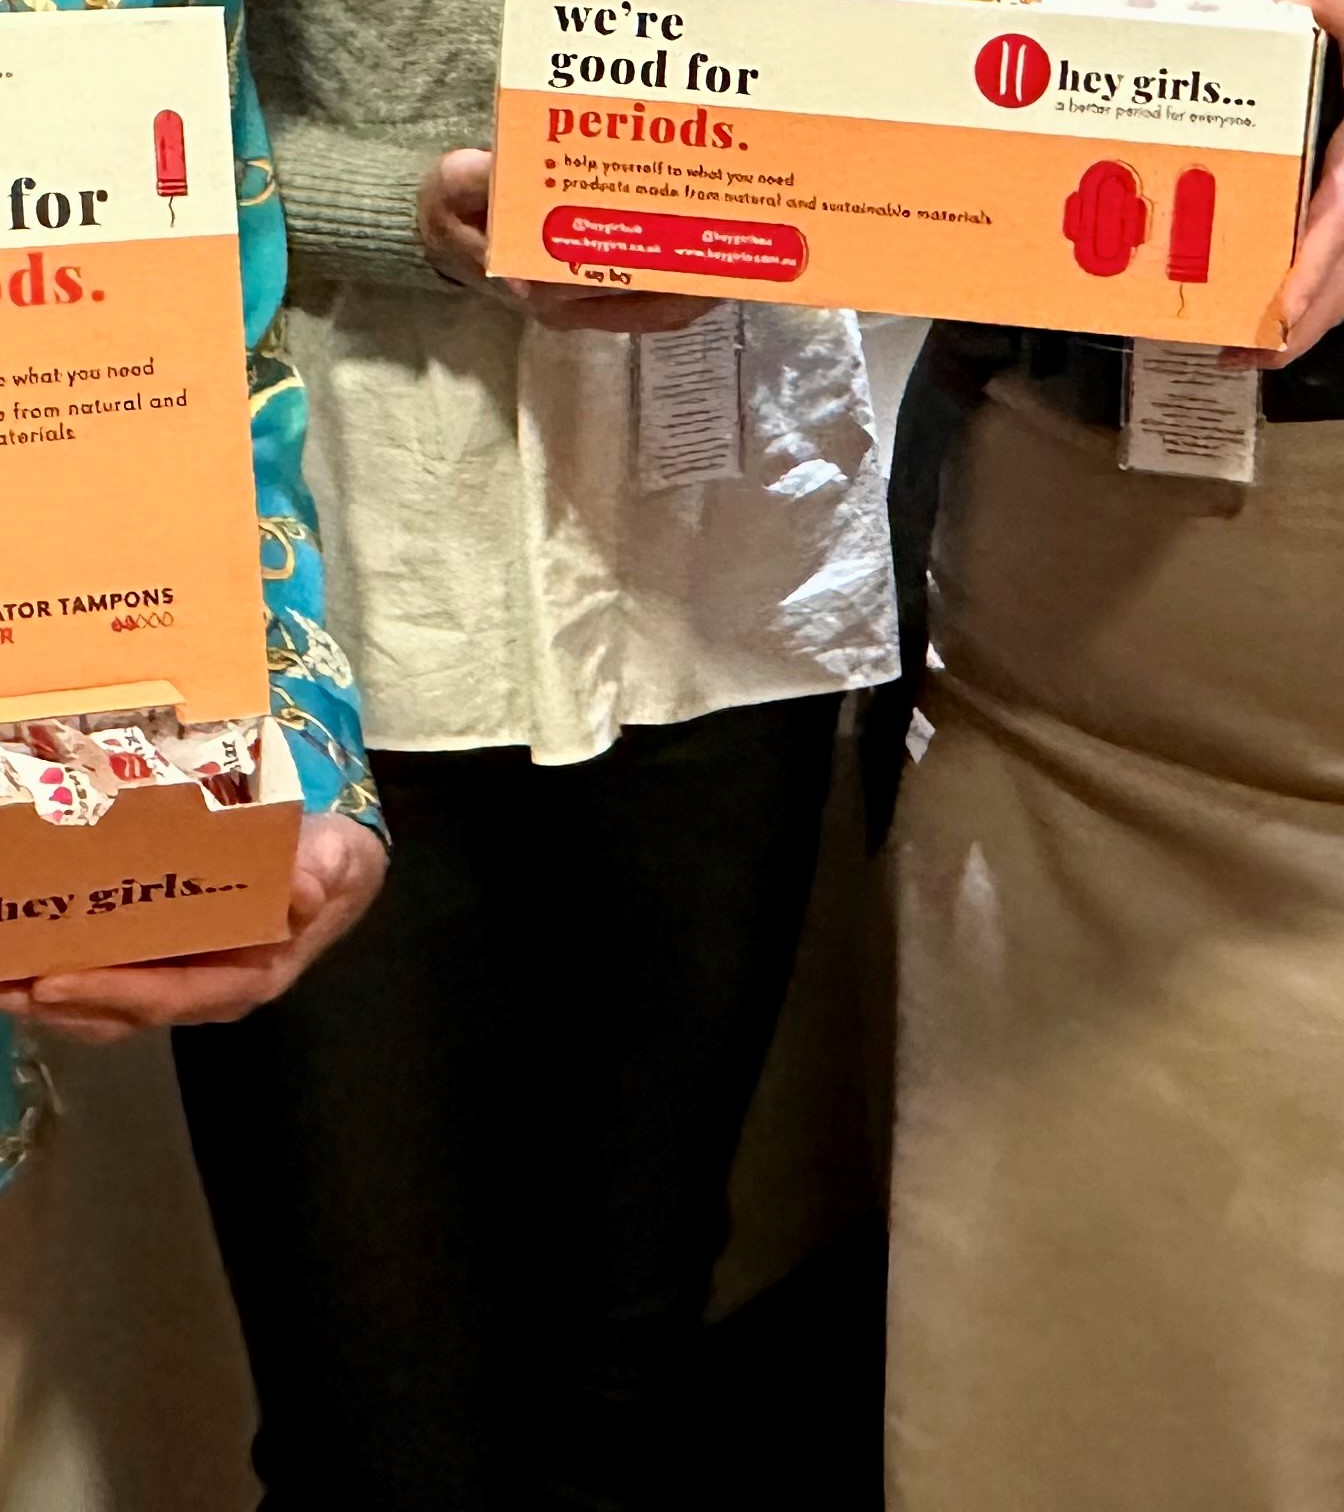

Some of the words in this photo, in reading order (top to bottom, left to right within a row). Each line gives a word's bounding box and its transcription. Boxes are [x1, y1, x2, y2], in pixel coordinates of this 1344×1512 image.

[555, 1, 685, 41] we're
[548, 50, 668, 89] good
[686, 52, 759, 96] for
[1058, 60, 1124, 102] hey
[1131, 68, 1256, 106] girls...
[547, 102, 749, 151] periods.
[1116, 105, 1161, 120] period
[1166, 105, 1186, 122] for
[564, 154, 597, 171] help
[602, 159, 663, 176] yourself
[668, 164, 682, 177] to
[687, 165, 723, 181] what
[726, 171, 753, 186] you
[758, 172, 795, 186] need
[8, 177, 109, 230] for
[562, 176, 630, 194] products
[636, 183, 679, 197] made
[684, 186, 720, 201] from
[724, 193, 782, 207] natural
[786, 197, 817, 210] and
[822, 201, 911, 218] sustainable
[917, 209, 993, 225] materials
[13, 367, 61, 385] what
[67, 368, 101, 386] you
[107, 357, 155, 379] need
[13, 402, 60, 421] from
[68, 393, 142, 416] natural
[149, 389, 188, 409] and
[58, 587, 175, 616] TAMPONS
[87, 874, 248, 916] girls...
